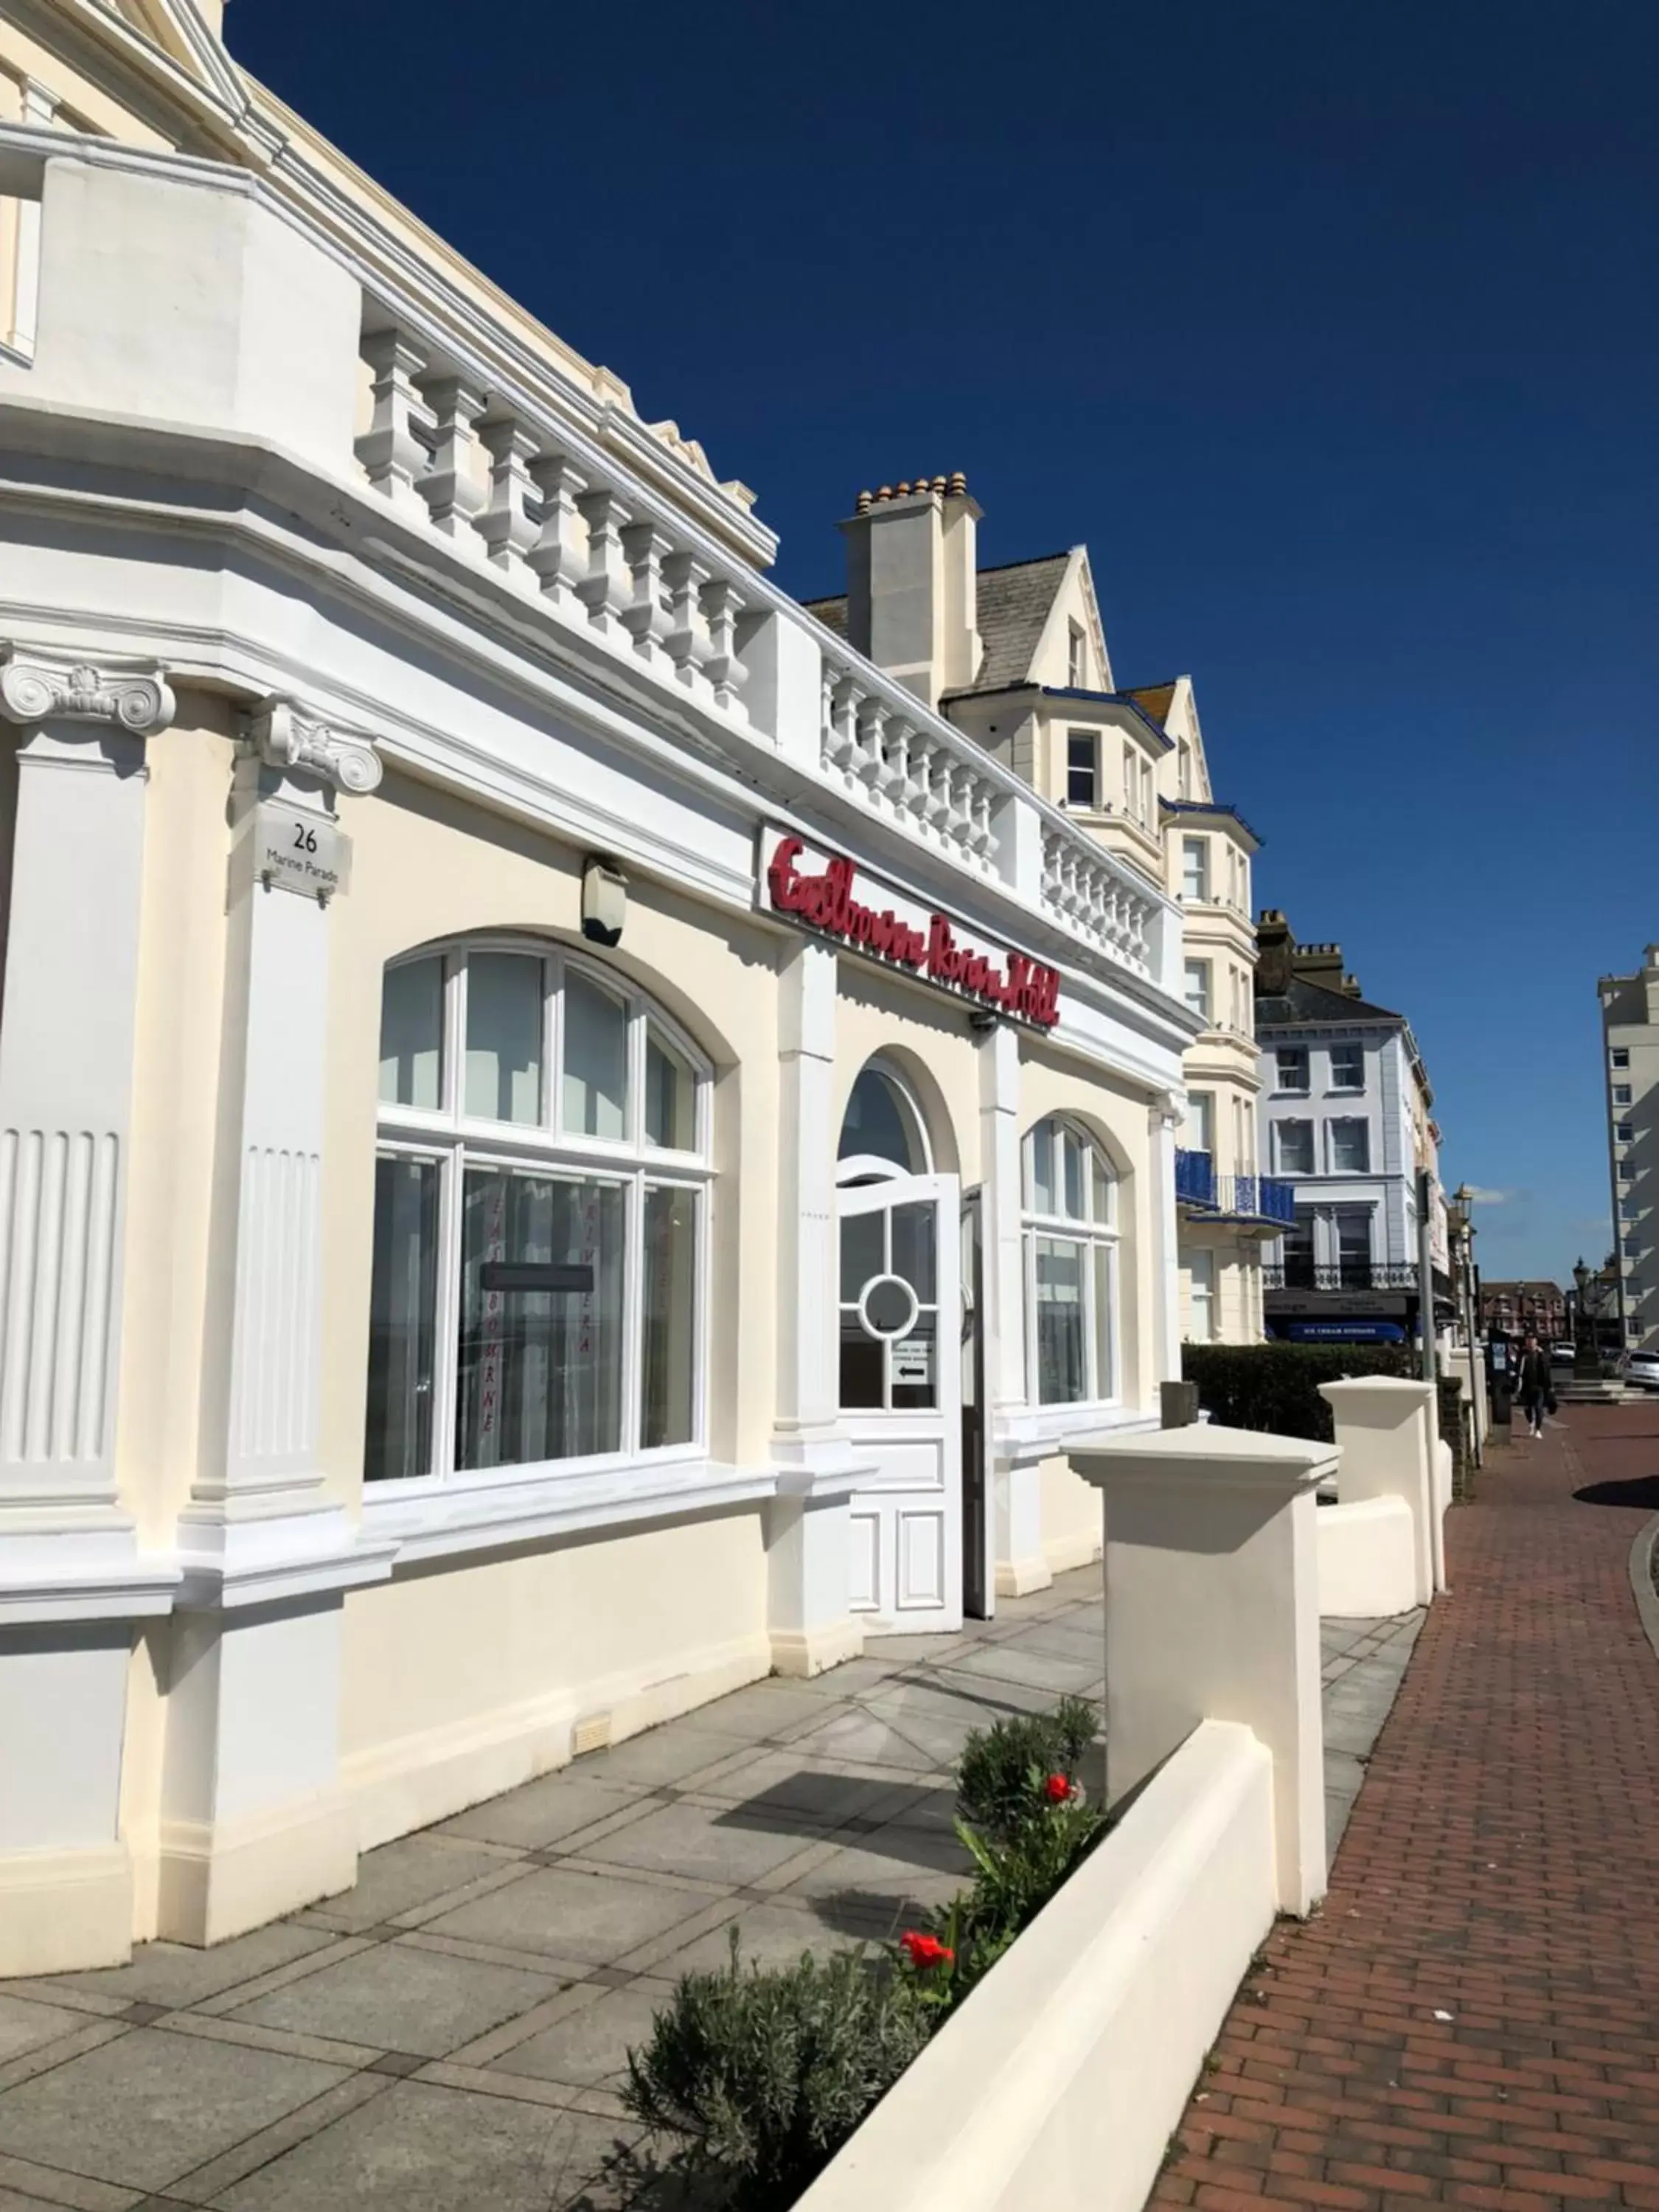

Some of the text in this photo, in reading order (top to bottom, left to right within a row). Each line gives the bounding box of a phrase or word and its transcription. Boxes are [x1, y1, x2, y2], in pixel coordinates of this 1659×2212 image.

[293, 822, 317, 853] 26
[266, 848, 338, 883] Marine Parade
[482, 1197, 502, 1433] EASBOURNE
